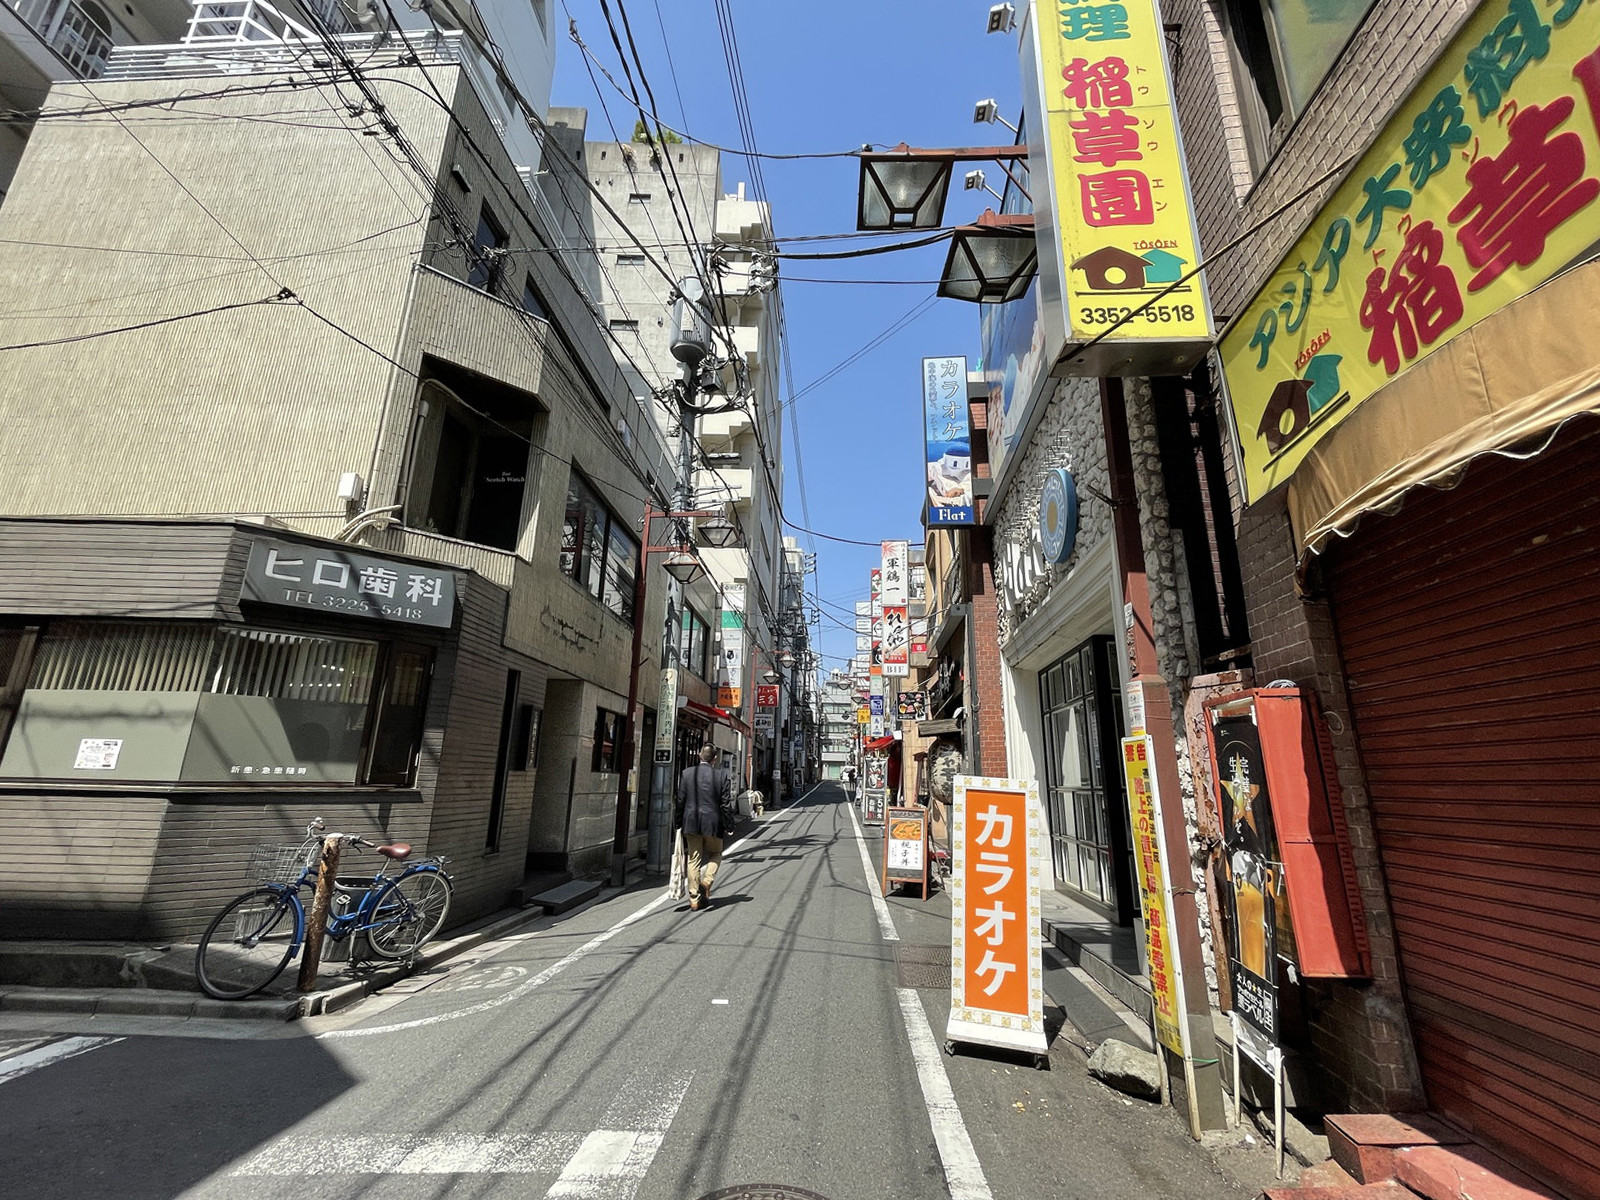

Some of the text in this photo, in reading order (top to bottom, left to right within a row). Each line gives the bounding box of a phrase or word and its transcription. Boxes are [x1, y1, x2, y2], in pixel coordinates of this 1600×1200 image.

[1058, 0, 1132, 42] 理
[1062, 57, 1155, 227] 稲草園
[1249, 0, 1590, 369] アジア大衆料
[1360, 40, 1600, 375] 稲草
[1080, 305, 1195, 325] 3352-5518
[941, 360, 963, 441] カラオケ
[939, 509, 966, 521] Flat
[265, 549, 443, 606] ヒロ歯科
[284, 588, 422, 619] TEL 3225-5418
[973, 804, 1016, 997] カラオケ
